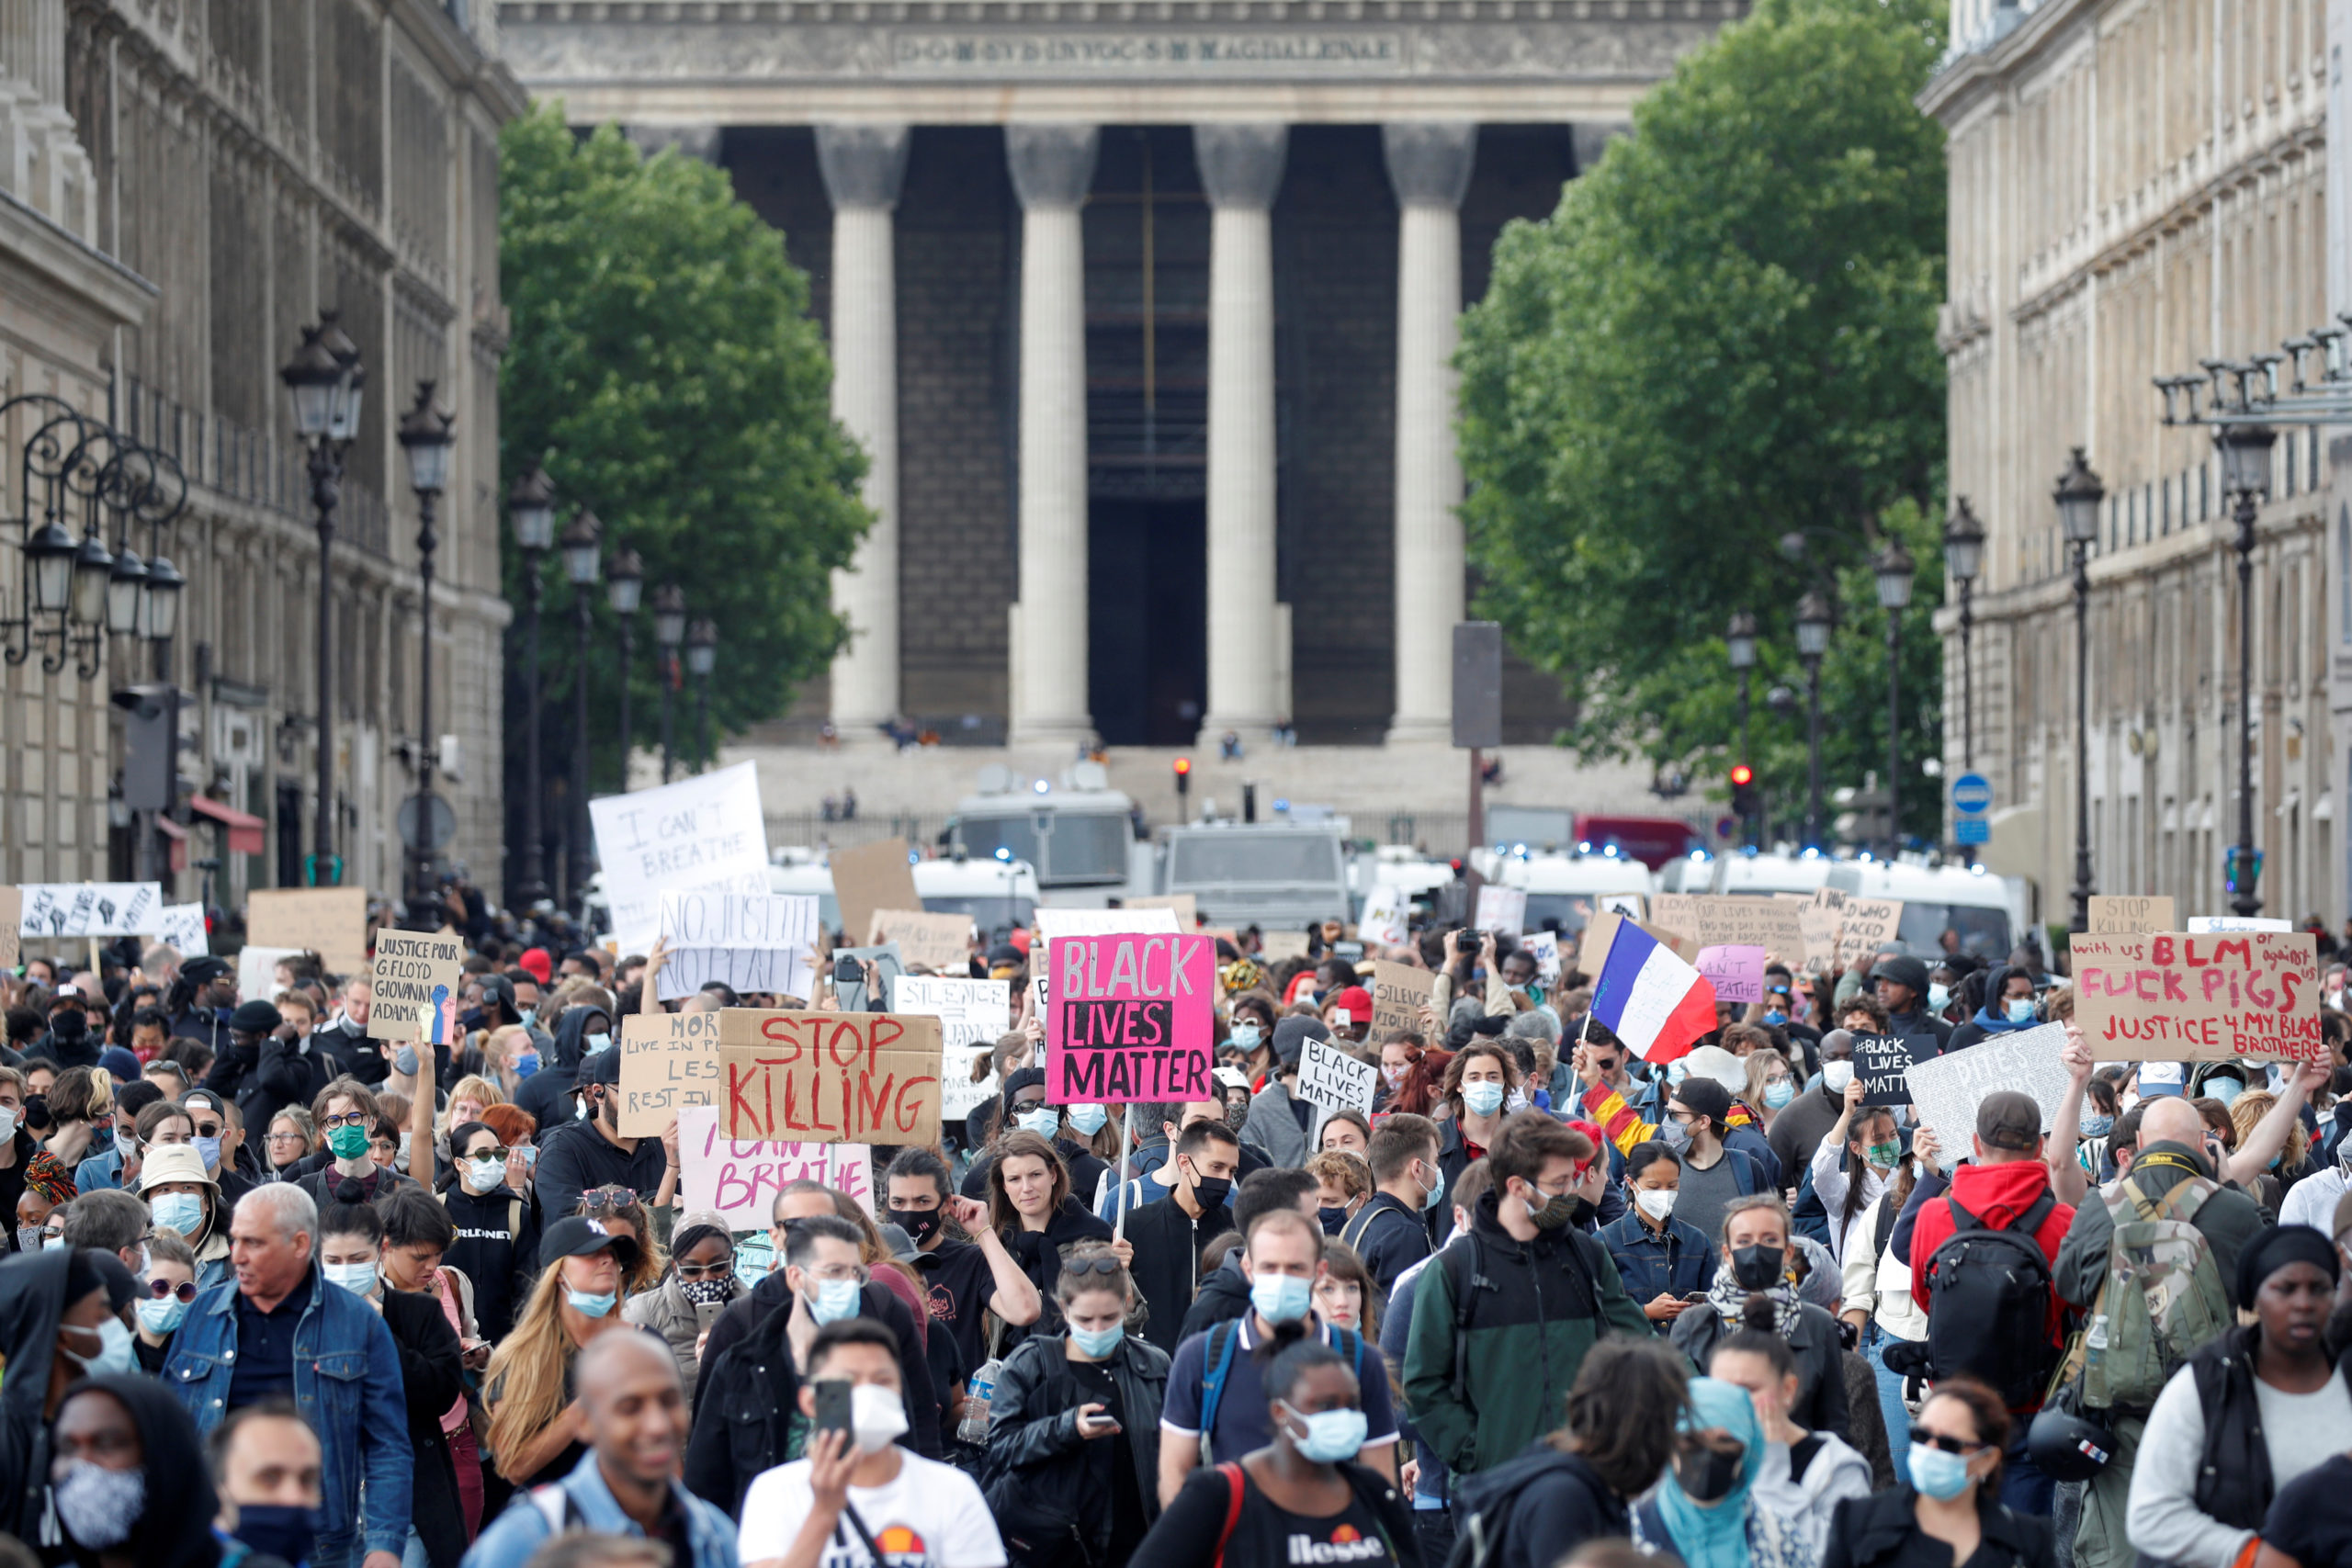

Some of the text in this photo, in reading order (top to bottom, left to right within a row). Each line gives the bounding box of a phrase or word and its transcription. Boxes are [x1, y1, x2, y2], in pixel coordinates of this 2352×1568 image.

[618, 802, 723, 852] I CAN'T
[642, 830, 749, 876] BREATHE
[660, 894, 706, 942] NO
[1860, 904, 1891, 919] WHO
[2106, 897, 2151, 918] STOP
[1841, 921, 1885, 938] RACED
[378, 938, 458, 961] JUSTICE POUR
[1722, 947, 1729, 960] I
[2072, 941, 2112, 955] with
[2152, 936, 2252, 972] BLM
[2256, 933, 2275, 945] or
[2262, 944, 2312, 972] against
[1062, 937, 1201, 999] BLACK
[1704, 961, 1747, 975] AN'T
[375, 979, 431, 1003] GIOVANNI
[902, 981, 1006, 1007] SILENCE
[1376, 983, 1430, 1008] SILENCE
[1711, 980, 1758, 998] EATHE
[2080, 967, 2188, 1003] FUCK
[373, 1002, 418, 1022] ADAMA
[671, 1012, 719, 1039] MOR
[1066, 1000, 1165, 1047] LIVES
[2223, 1014, 2239, 1033] 4
[2244, 1011, 2275, 1034] MY
[2278, 1012, 2323, 1040] BLACK
[667, 1040, 694, 1052] IN
[755, 1015, 905, 1077] STOP
[1854, 1037, 1908, 1054] #BLACK
[2233, 1032, 2322, 1061] BROTHERS
[668, 1059, 720, 1081] LES
[1063, 1049, 1208, 1099] MATTER
[1308, 1040, 1369, 1087] BLACK
[1868, 1055, 1914, 1070] LIVES
[1953, 1043, 2029, 1088] DITES
[1314, 1066, 1364, 1104] LIVES
[1864, 1073, 1907, 1095] MATT
[628, 1087, 711, 1114] REST IN
[963, 1093, 992, 1103] NEC
[704, 1122, 717, 1158] I
[2145, 1155, 2174, 1165] Nikon
[715, 1158, 868, 1211] BREATHE
